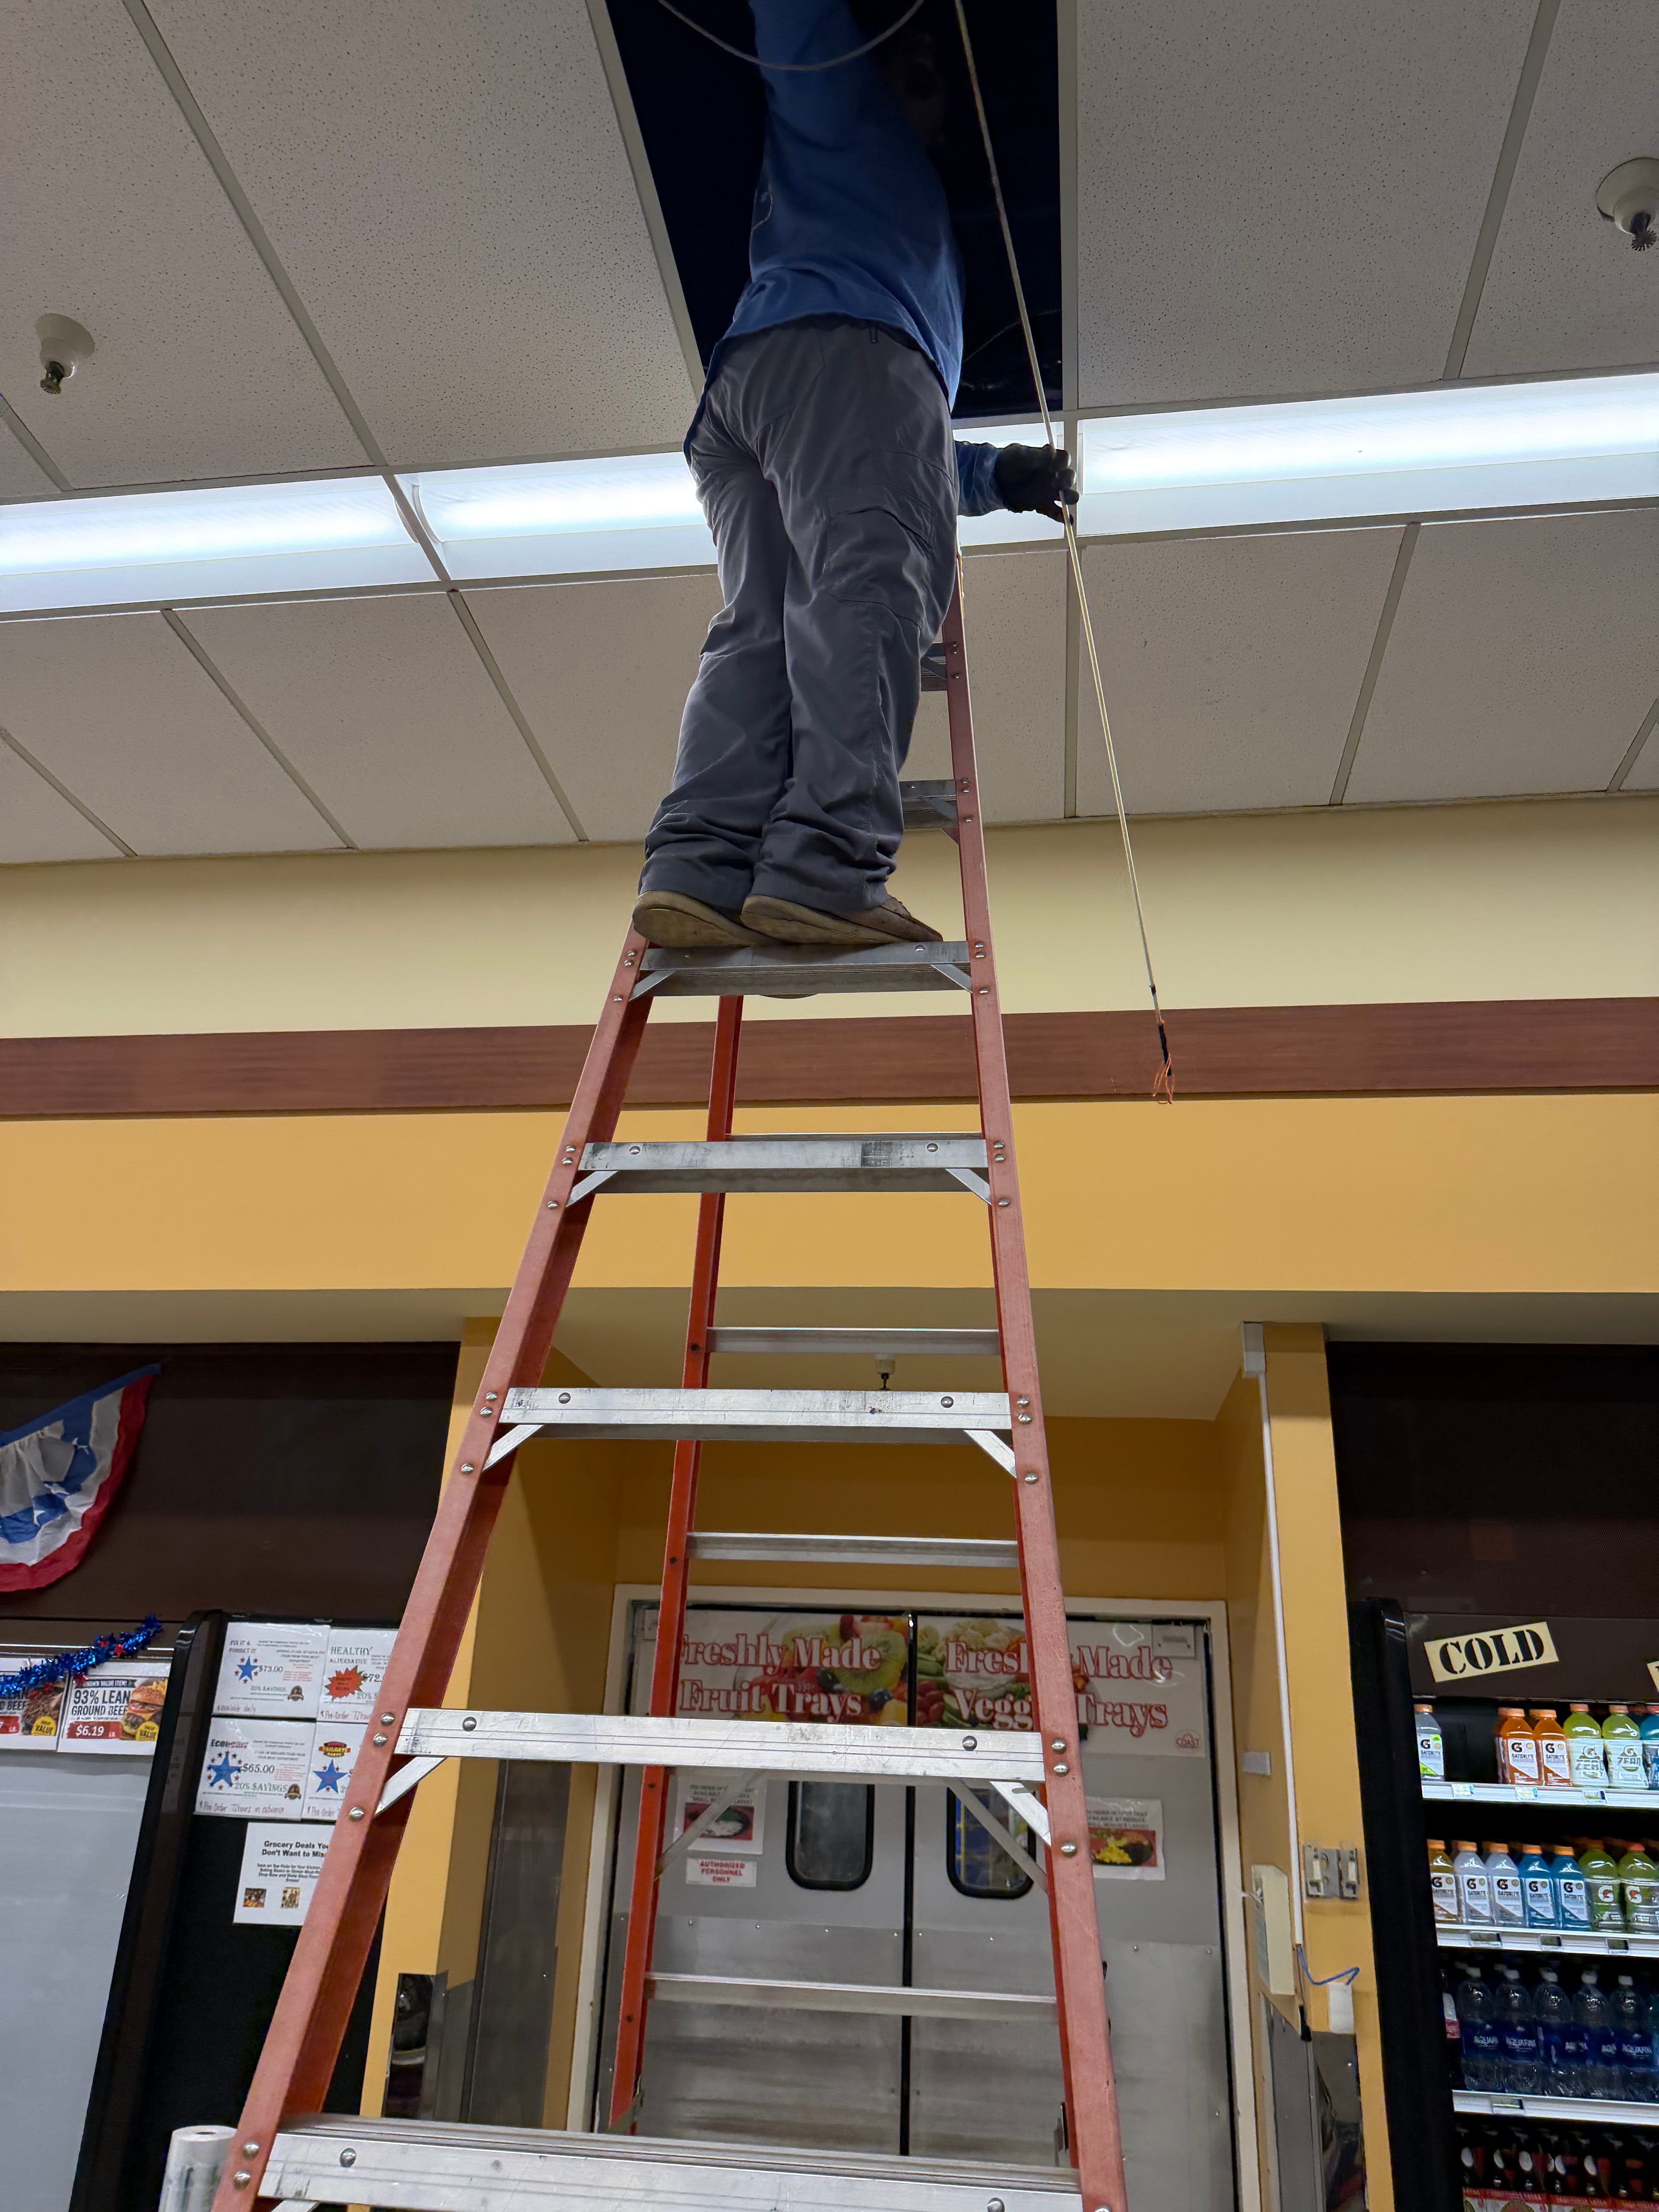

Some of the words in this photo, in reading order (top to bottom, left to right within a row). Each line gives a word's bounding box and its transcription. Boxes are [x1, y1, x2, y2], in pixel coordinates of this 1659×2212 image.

[331, 1646, 373, 1656] HEALTHY
[793, 1637, 882, 1670] Made
[1440, 1629, 1544, 1675] COLD
[1077, 1645, 1173, 1680] Made
[362, 1672, 382, 1682] $72.
[73, 1690, 99, 1704] 93%
[102, 1690, 131, 1704] LEAN
[680, 1679, 766, 1712] Fruit
[772, 1684, 863, 1723] Trays
[72, 1706, 105, 1716] GROUND
[108, 1706, 128, 1716] BEEF
[953, 1689, 1033, 1729] Vegg
[76, 1724, 105, 1737] $6.19
[242, 1764, 275, 1773] $65.00
[252, 1783, 288, 1792] SAVINGS
[264, 1840, 294, 1849] Grocery
[1505, 2035, 1536, 2047] AQUAFIN
[1621, 2043, 1652, 2054] AQUAFIN
